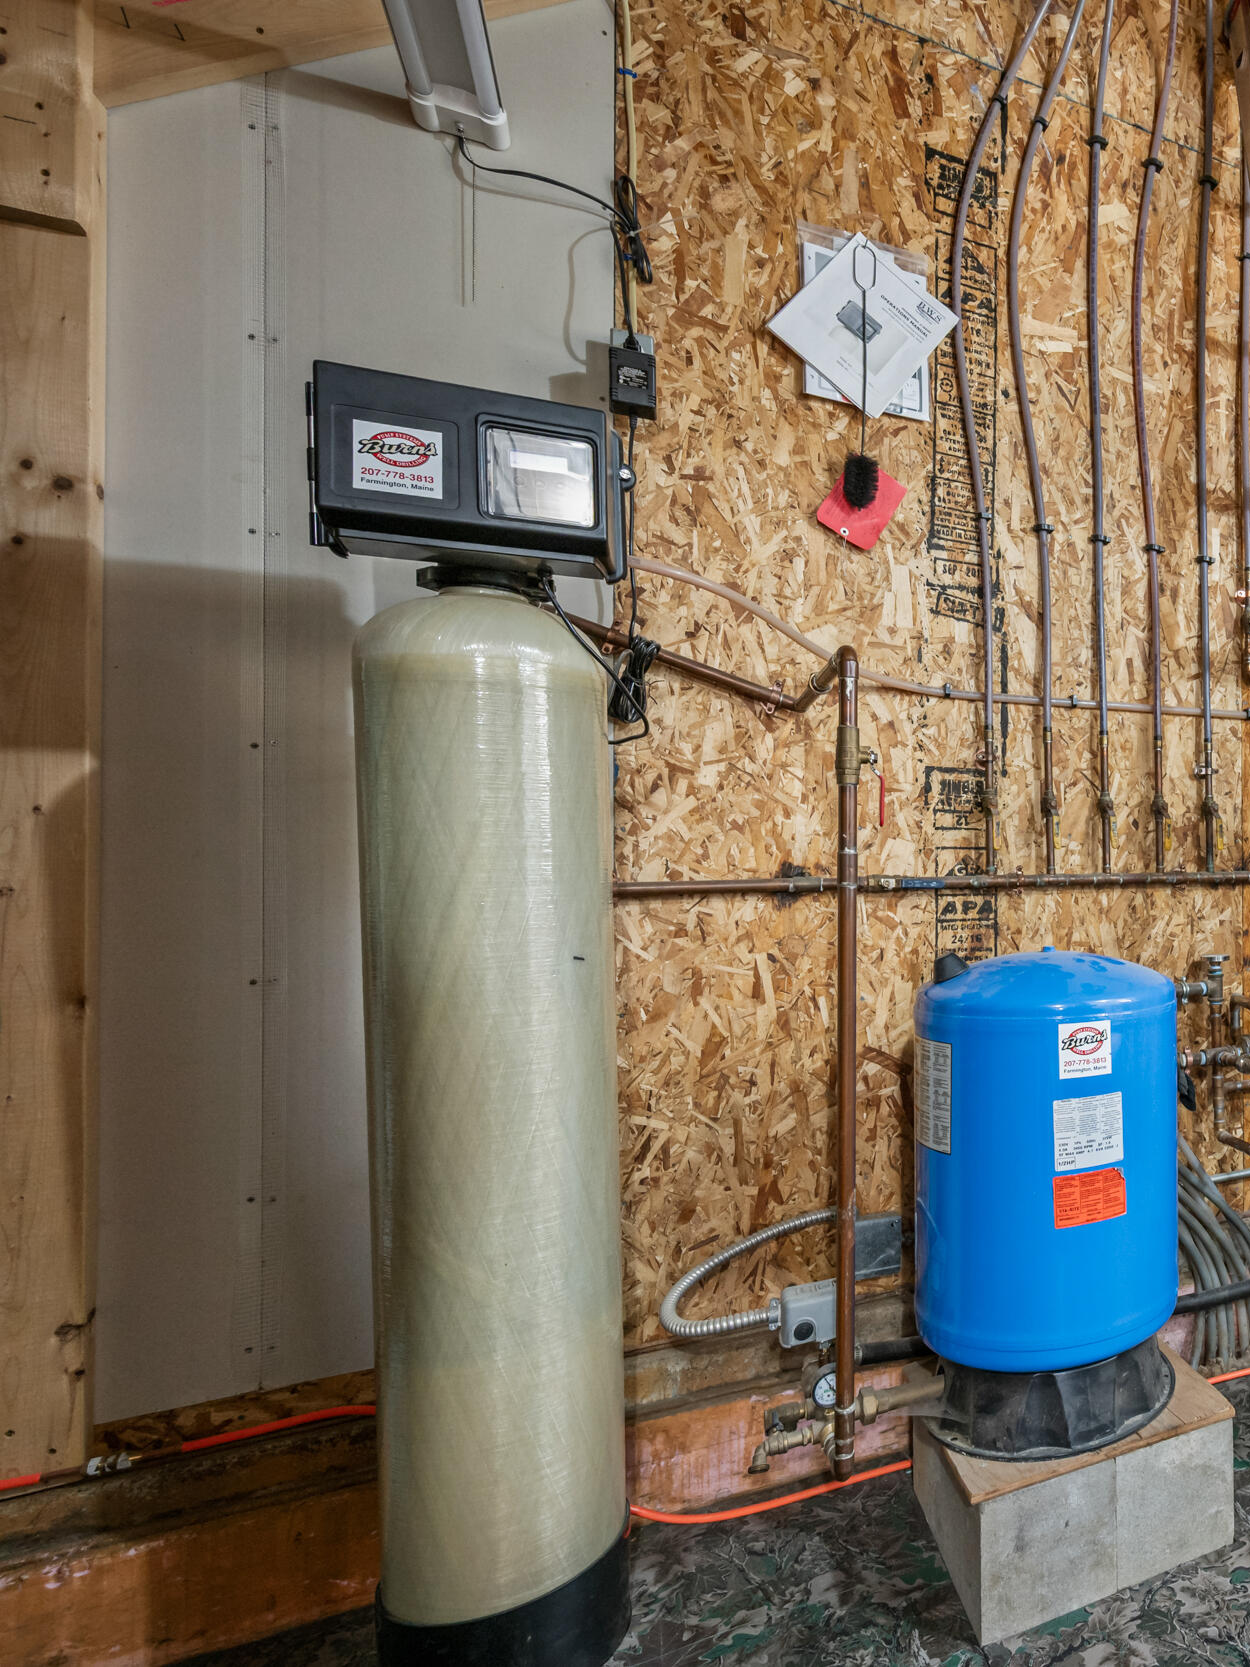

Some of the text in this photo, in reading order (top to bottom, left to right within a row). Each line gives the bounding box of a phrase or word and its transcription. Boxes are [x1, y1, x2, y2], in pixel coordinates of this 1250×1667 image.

[358, 439, 438, 456] Burns
[361, 467, 434, 484] 207-778-3813
[361, 477, 434, 492] Farmington, Maine
[943, 564, 981, 578] SEP 201
[940, 901, 994, 915] APA
[1062, 1029, 1108, 1050] Burns
[1063, 1057, 1107, 1067] 207-778-3813
